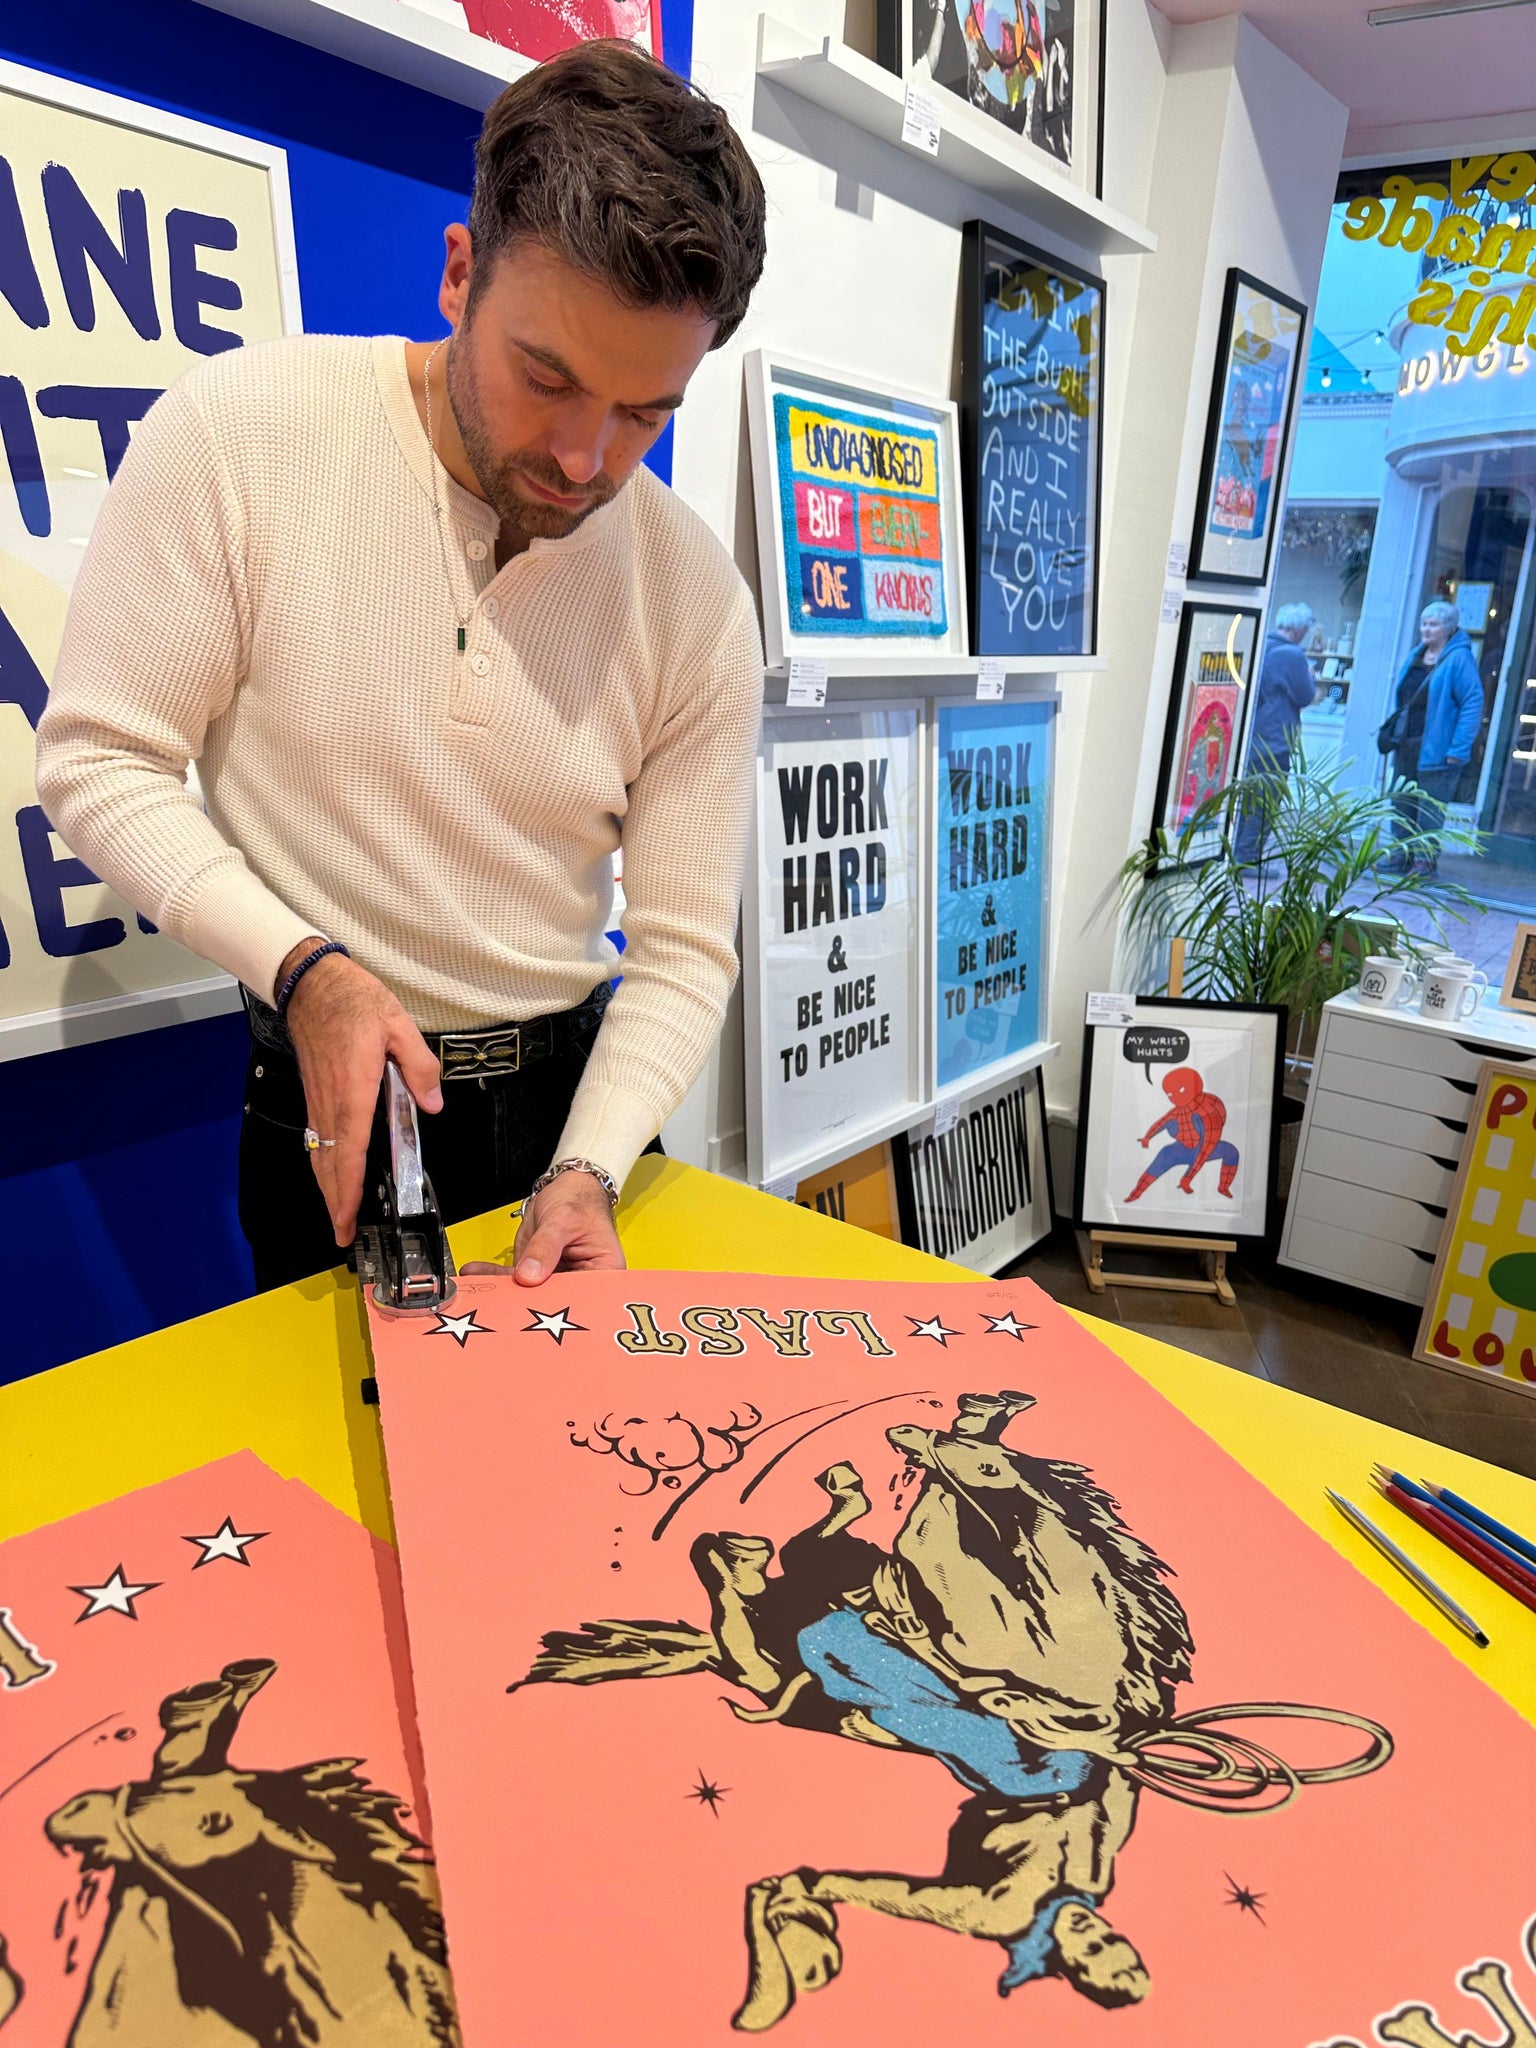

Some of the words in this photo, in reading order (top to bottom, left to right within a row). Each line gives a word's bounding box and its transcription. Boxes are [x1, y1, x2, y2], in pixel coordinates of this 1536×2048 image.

[983, 325, 1027, 376] THE
[1035, 349, 1085, 403] BUSH
[982, 379, 1081, 452] OUTSIDE
[804, 422, 923, 488] UNDIAGNOSED
[982, 426, 1039, 485] AND
[1046, 452, 1068, 499] I
[807, 489, 844, 539] BUT
[986, 485, 1081, 552] REALLY
[811, 561, 851, 610] ONE
[875, 572, 933, 617] KNOWS
[989, 532, 1074, 587] LOVE
[1001, 584, 1069, 634] YOU
[777, 758, 889, 846] WORK
[948, 741, 1032, 817] WORK
[949, 814, 1027, 893] HARD
[783, 841, 887, 935] HARD
[981, 894, 997, 927] &
[827, 935, 848, 973] &
[958, 943, 978, 976] BE
[985, 930, 1018, 968] NICE
[797, 995, 823, 1032] BE
[834, 975, 876, 1018] NICE
[944, 989, 965, 1020] TO
[974, 964, 1027, 1009] PEOPLE
[780, 1047, 808, 1083] TO
[819, 1014, 891, 1070] PEOPLE
[1126, 1036, 1144, 1045] MY
[1150, 1036, 1186, 1046] WRIST
[1137, 1048, 1173, 1057] HURTS
[909, 1087, 1032, 1260] TOMORROW
[613, 1300, 898, 1360] LAST
